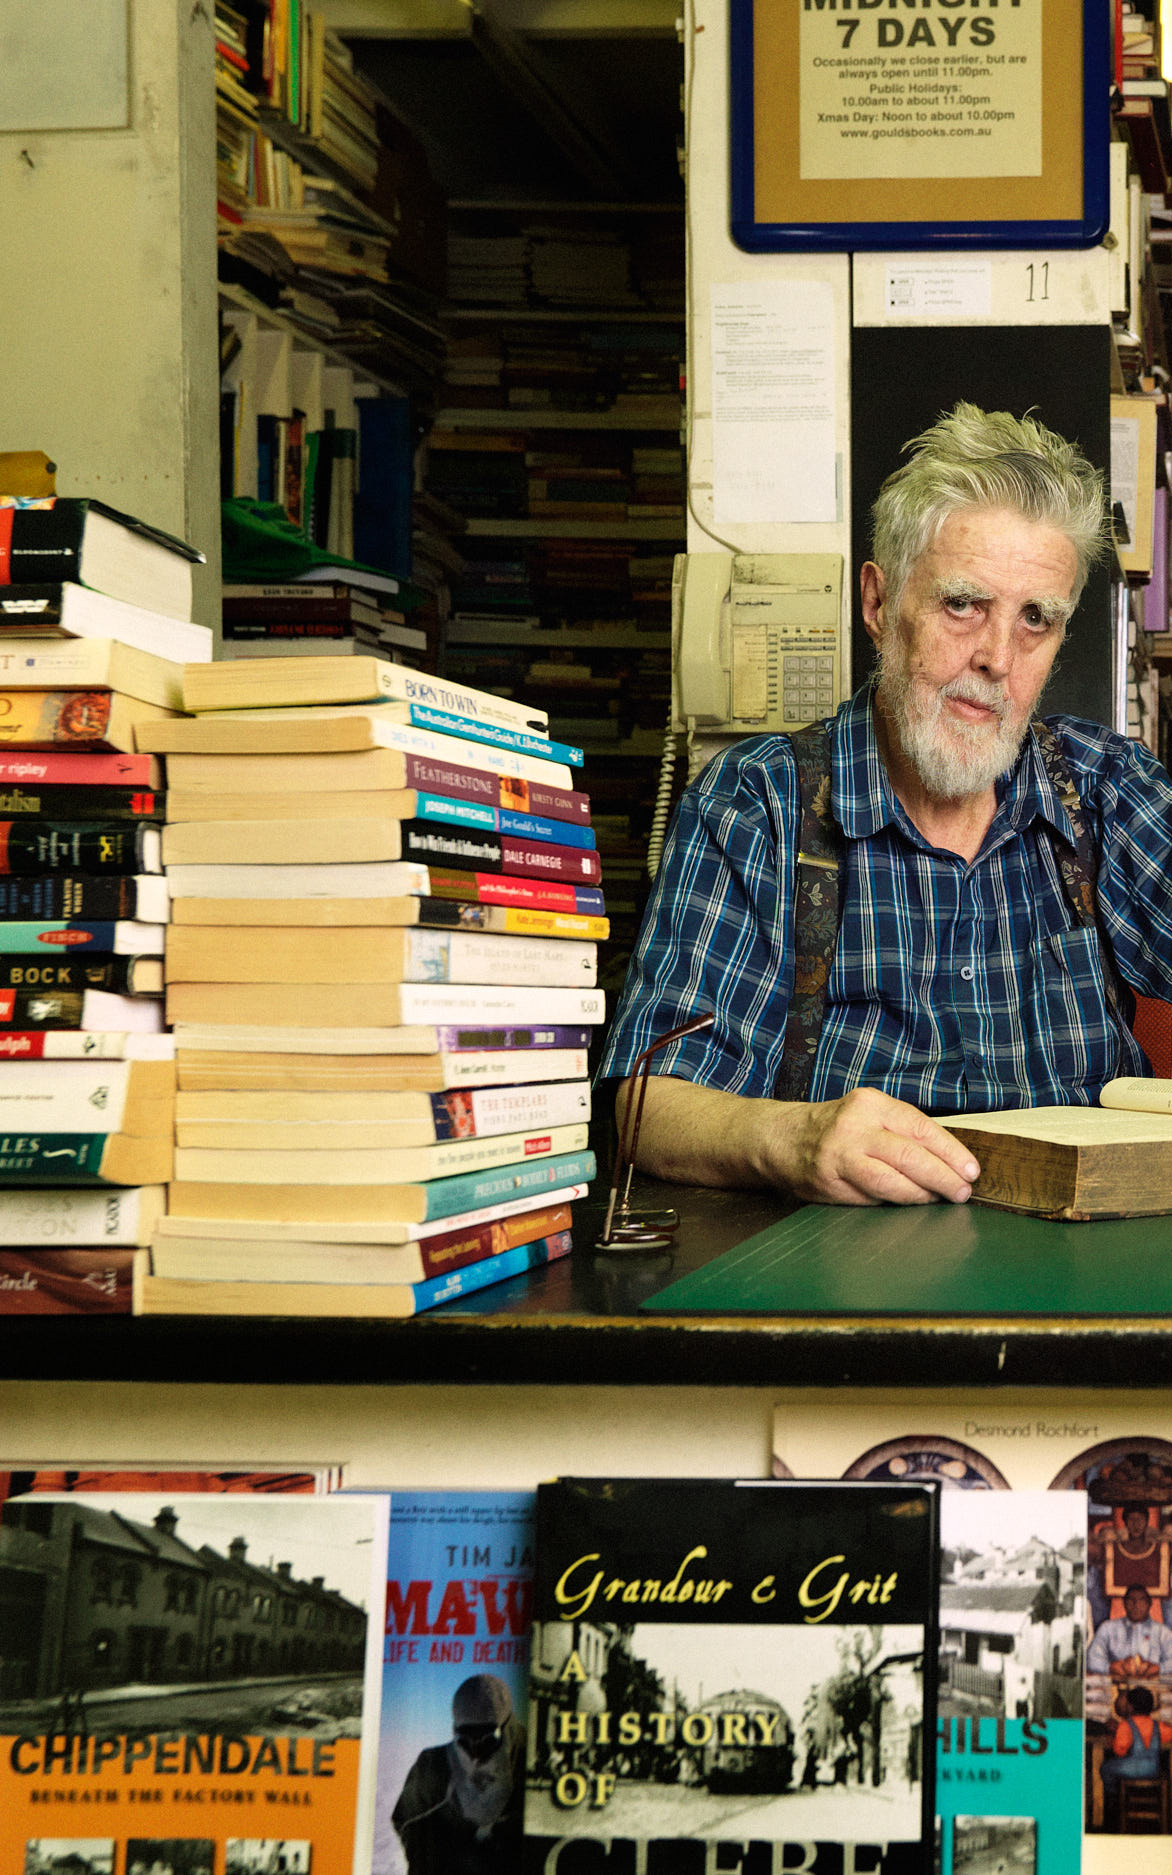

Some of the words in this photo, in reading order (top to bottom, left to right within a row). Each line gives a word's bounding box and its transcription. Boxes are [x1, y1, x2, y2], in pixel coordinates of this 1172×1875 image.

[837, 19, 861, 49] 7
[878, 17, 996, 48] DAYS
[813, 56, 886, 68] Occasionally
[909, 55, 938, 65] close
[943, 55, 981, 66] earlier,
[986, 54, 1005, 64] but
[1008, 56, 1027, 64] are
[838, 69, 878, 80] always
[881, 70, 909, 79] open
[913, 66, 939, 77] until
[943, 66, 993, 78] 11.00pm.
[869, 83, 904, 94] Public
[908, 83, 962, 95] Holidays:
[842, 96, 888, 107] 10.00am
[892, 97, 904, 106] to
[906, 96, 939, 106] about
[943, 95, 991, 107] 11.00pm
[817, 113, 849, 123] Xmas
[853, 112, 878, 124] Day:
[881, 112, 912, 122] Noon
[916, 112, 927, 121] to
[930, 111, 963, 121] about
[967, 110, 1015, 122] 10.00pm
[840, 127, 992, 140] www.gouldsbooks.com.au
[405, 679, 438, 705] BORN
[439, 689, 454, 707] TO
[454, 694, 478, 717] WIN
[9, 762, 48, 779] ripley
[412, 760, 494, 795] FEATHERSTONE
[425, 800, 454, 816] JOSEPH
[455, 804, 495, 824] MITCHELL
[504, 849, 525, 865] DALE
[525, 850, 562, 870] CARNEGIE
[63, 879, 73, 918] FRANCIS
[73, 883, 83, 914] WHEEN
[43, 932, 90, 944] FINCH
[10, 967, 72, 984] BOCK
[964, 1422, 1031, 1438] Desmond
[1036, 1422, 1099, 1438] Rochfort
[446, 1545, 491, 1568] TIM
[798, 1555, 898, 1624] Grit
[429, 1640, 465, 1664] AND
[561, 1652, 587, 1682] A
[560, 1711, 783, 1747] HISTORY
[9, 1736, 336, 1778] CHIPPENDALE
[30, 1789, 118, 1806] BENEATH
[128, 1790, 164, 1806] THE
[173, 1789, 258, 1805] FACTORY
[266, 1789, 312, 1806] WALL
[556, 1773, 617, 1809] OF
